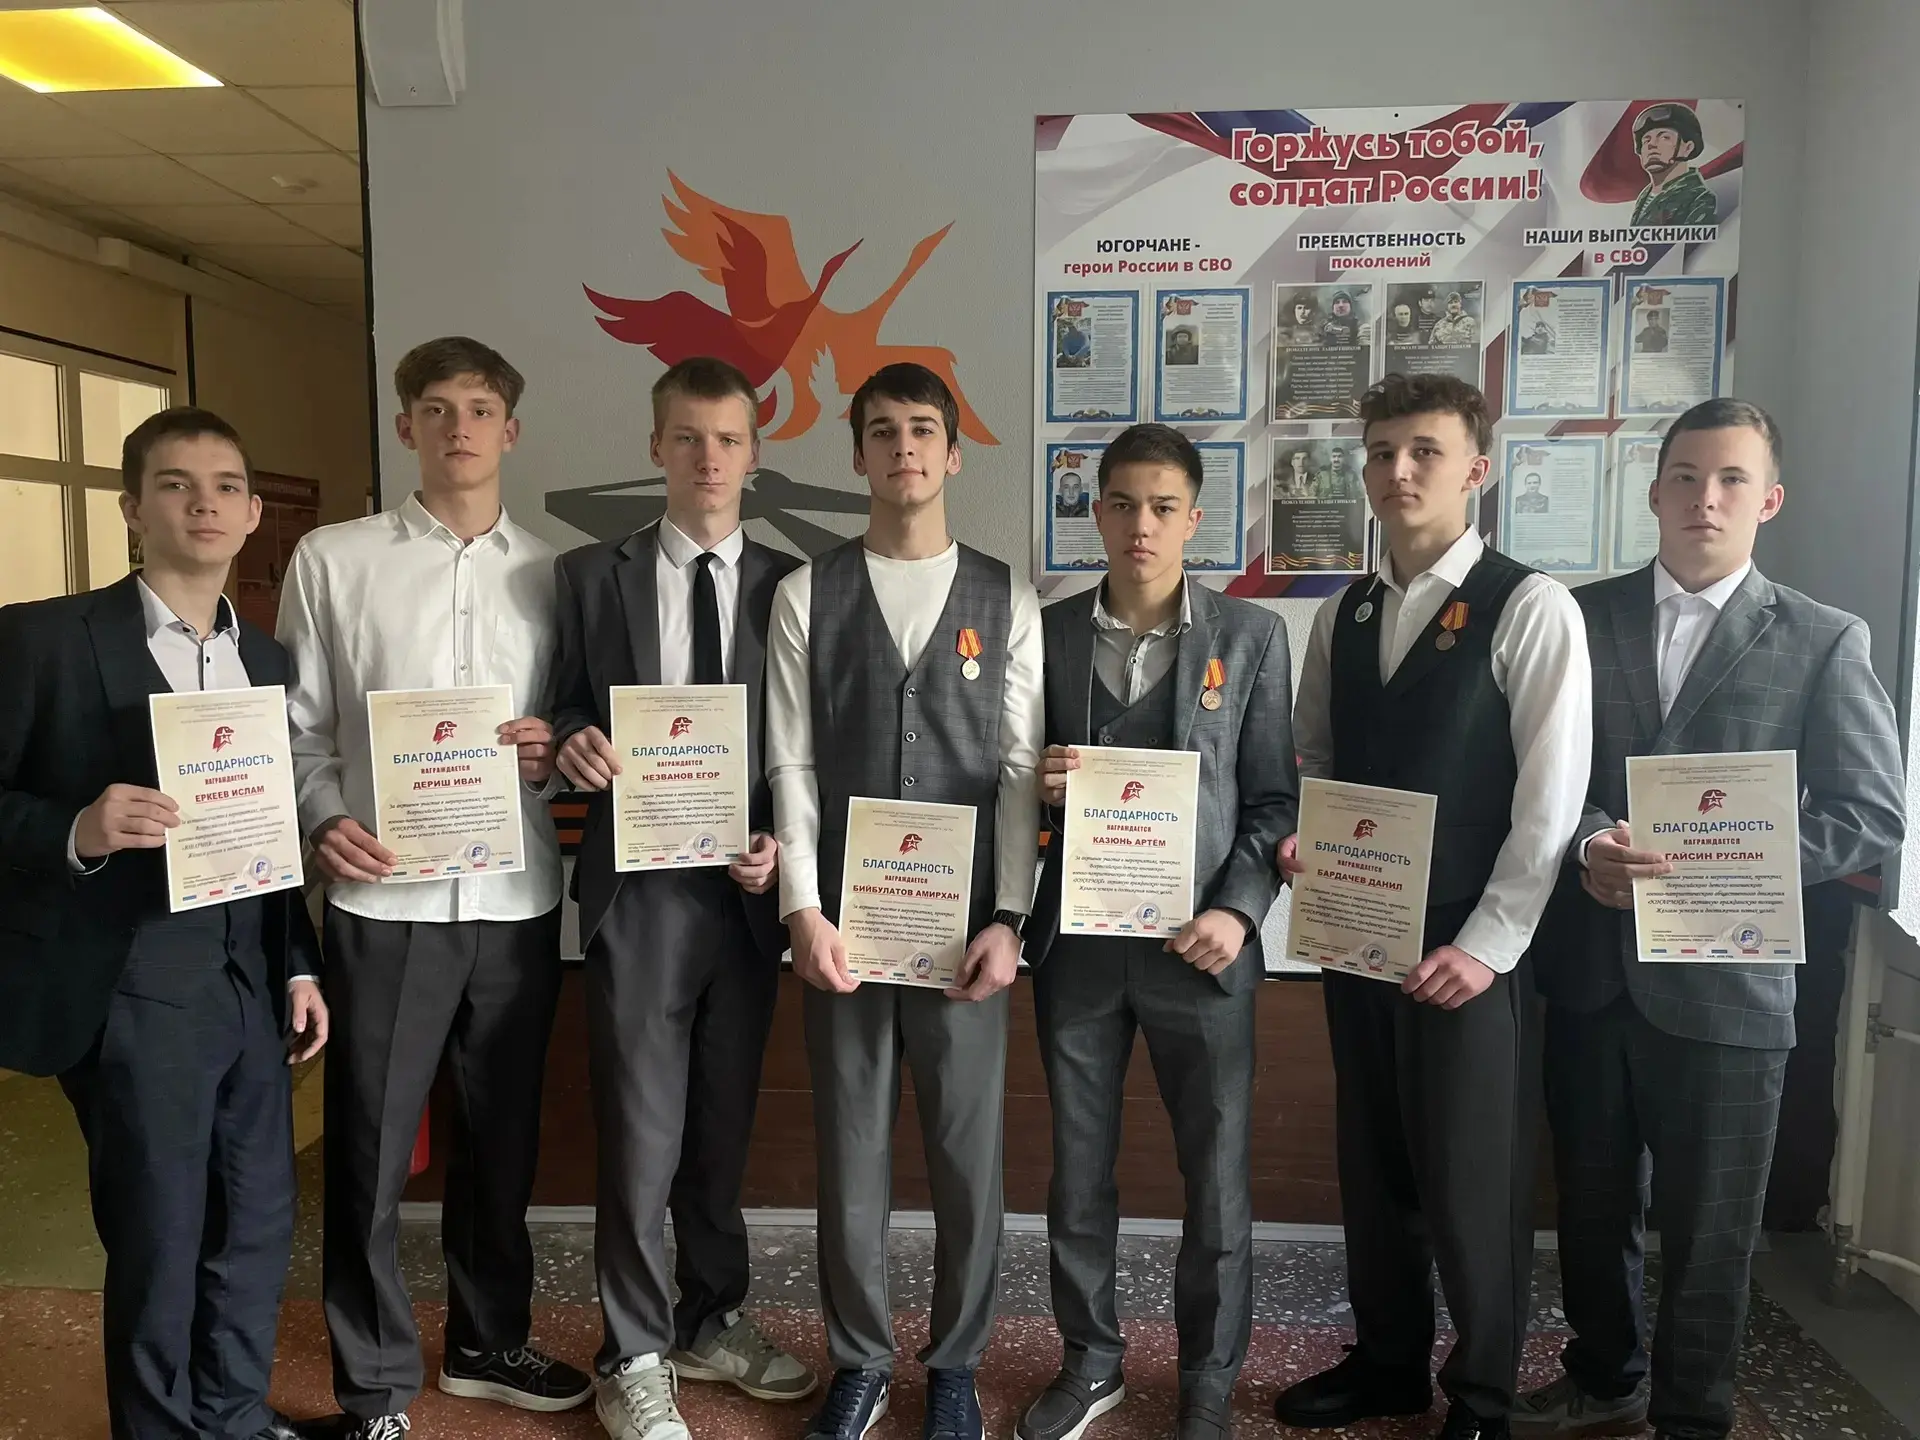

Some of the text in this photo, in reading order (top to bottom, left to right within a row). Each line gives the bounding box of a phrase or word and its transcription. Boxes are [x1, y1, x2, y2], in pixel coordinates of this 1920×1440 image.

[1232, 120, 1544, 171] Горжусь тобой,
[1230, 169, 1543, 208] солдат России!
[1299, 232, 1466, 248] ПРЕЕМСТВЕННОСТЬ
[1526, 228, 1716, 244] НАШИ ВЫПУСКНИКИ
[1097, 238, 1190, 252] ЮГОРЧАНЕ
[1332, 252, 1431, 268] поколений
[1594, 249, 1645, 263] в СВО
[1064, 258, 1232, 277] герои России в СВО
[393, 747, 497, 765] БЛАГОДАРНОСТЬ
[631, 744, 728, 757] БЛАГОДАРНОСТЬ
[178, 753, 274, 776] БЛАГОДАРНОСТЬ
[420, 764, 470, 774] НАГРАЖДАЕТСЯ
[656, 759, 702, 767] НАГРАЖДАЕТСЯ
[204, 773, 248, 785] НАГРАЖДАЕТСЯ
[413, 776, 481, 789] ДЕРИШ ИВАН
[642, 772, 693, 780] НЕЗВАНОВ
[194, 785, 264, 802] ЕРКЕЕВ ИСЛАМ
[1083, 808, 1178, 823] БЛАГОДАРНОСТЬ
[1106, 824, 1151, 832] НАГРАЖДАЕТСЯ
[1652, 820, 1774, 834] БЛАГОДАРНОСТЬ
[1092, 836, 1132, 845] КАЗЮНЬ
[1683, 837, 1740, 845] НАГРАЖДАЕТСЯ
[1315, 840, 1411, 866] БЛАГОДАРНОСТЬ
[1664, 851, 1763, 861] ГАЙСИН РУСЛАН
[862, 858, 954, 875] БЛАГОДАРНОСТЬ
[1337, 859, 1382, 873] НАГРАЖДАЕТСЯ
[884, 874, 928, 883] НАГРАЖДАЕТСЯ
[1317, 868, 1402, 891] БАРДАЧЕВ ДАНИЛ
[852, 883, 959, 900] БИЙБУЛАТОВ АМИРХАН
